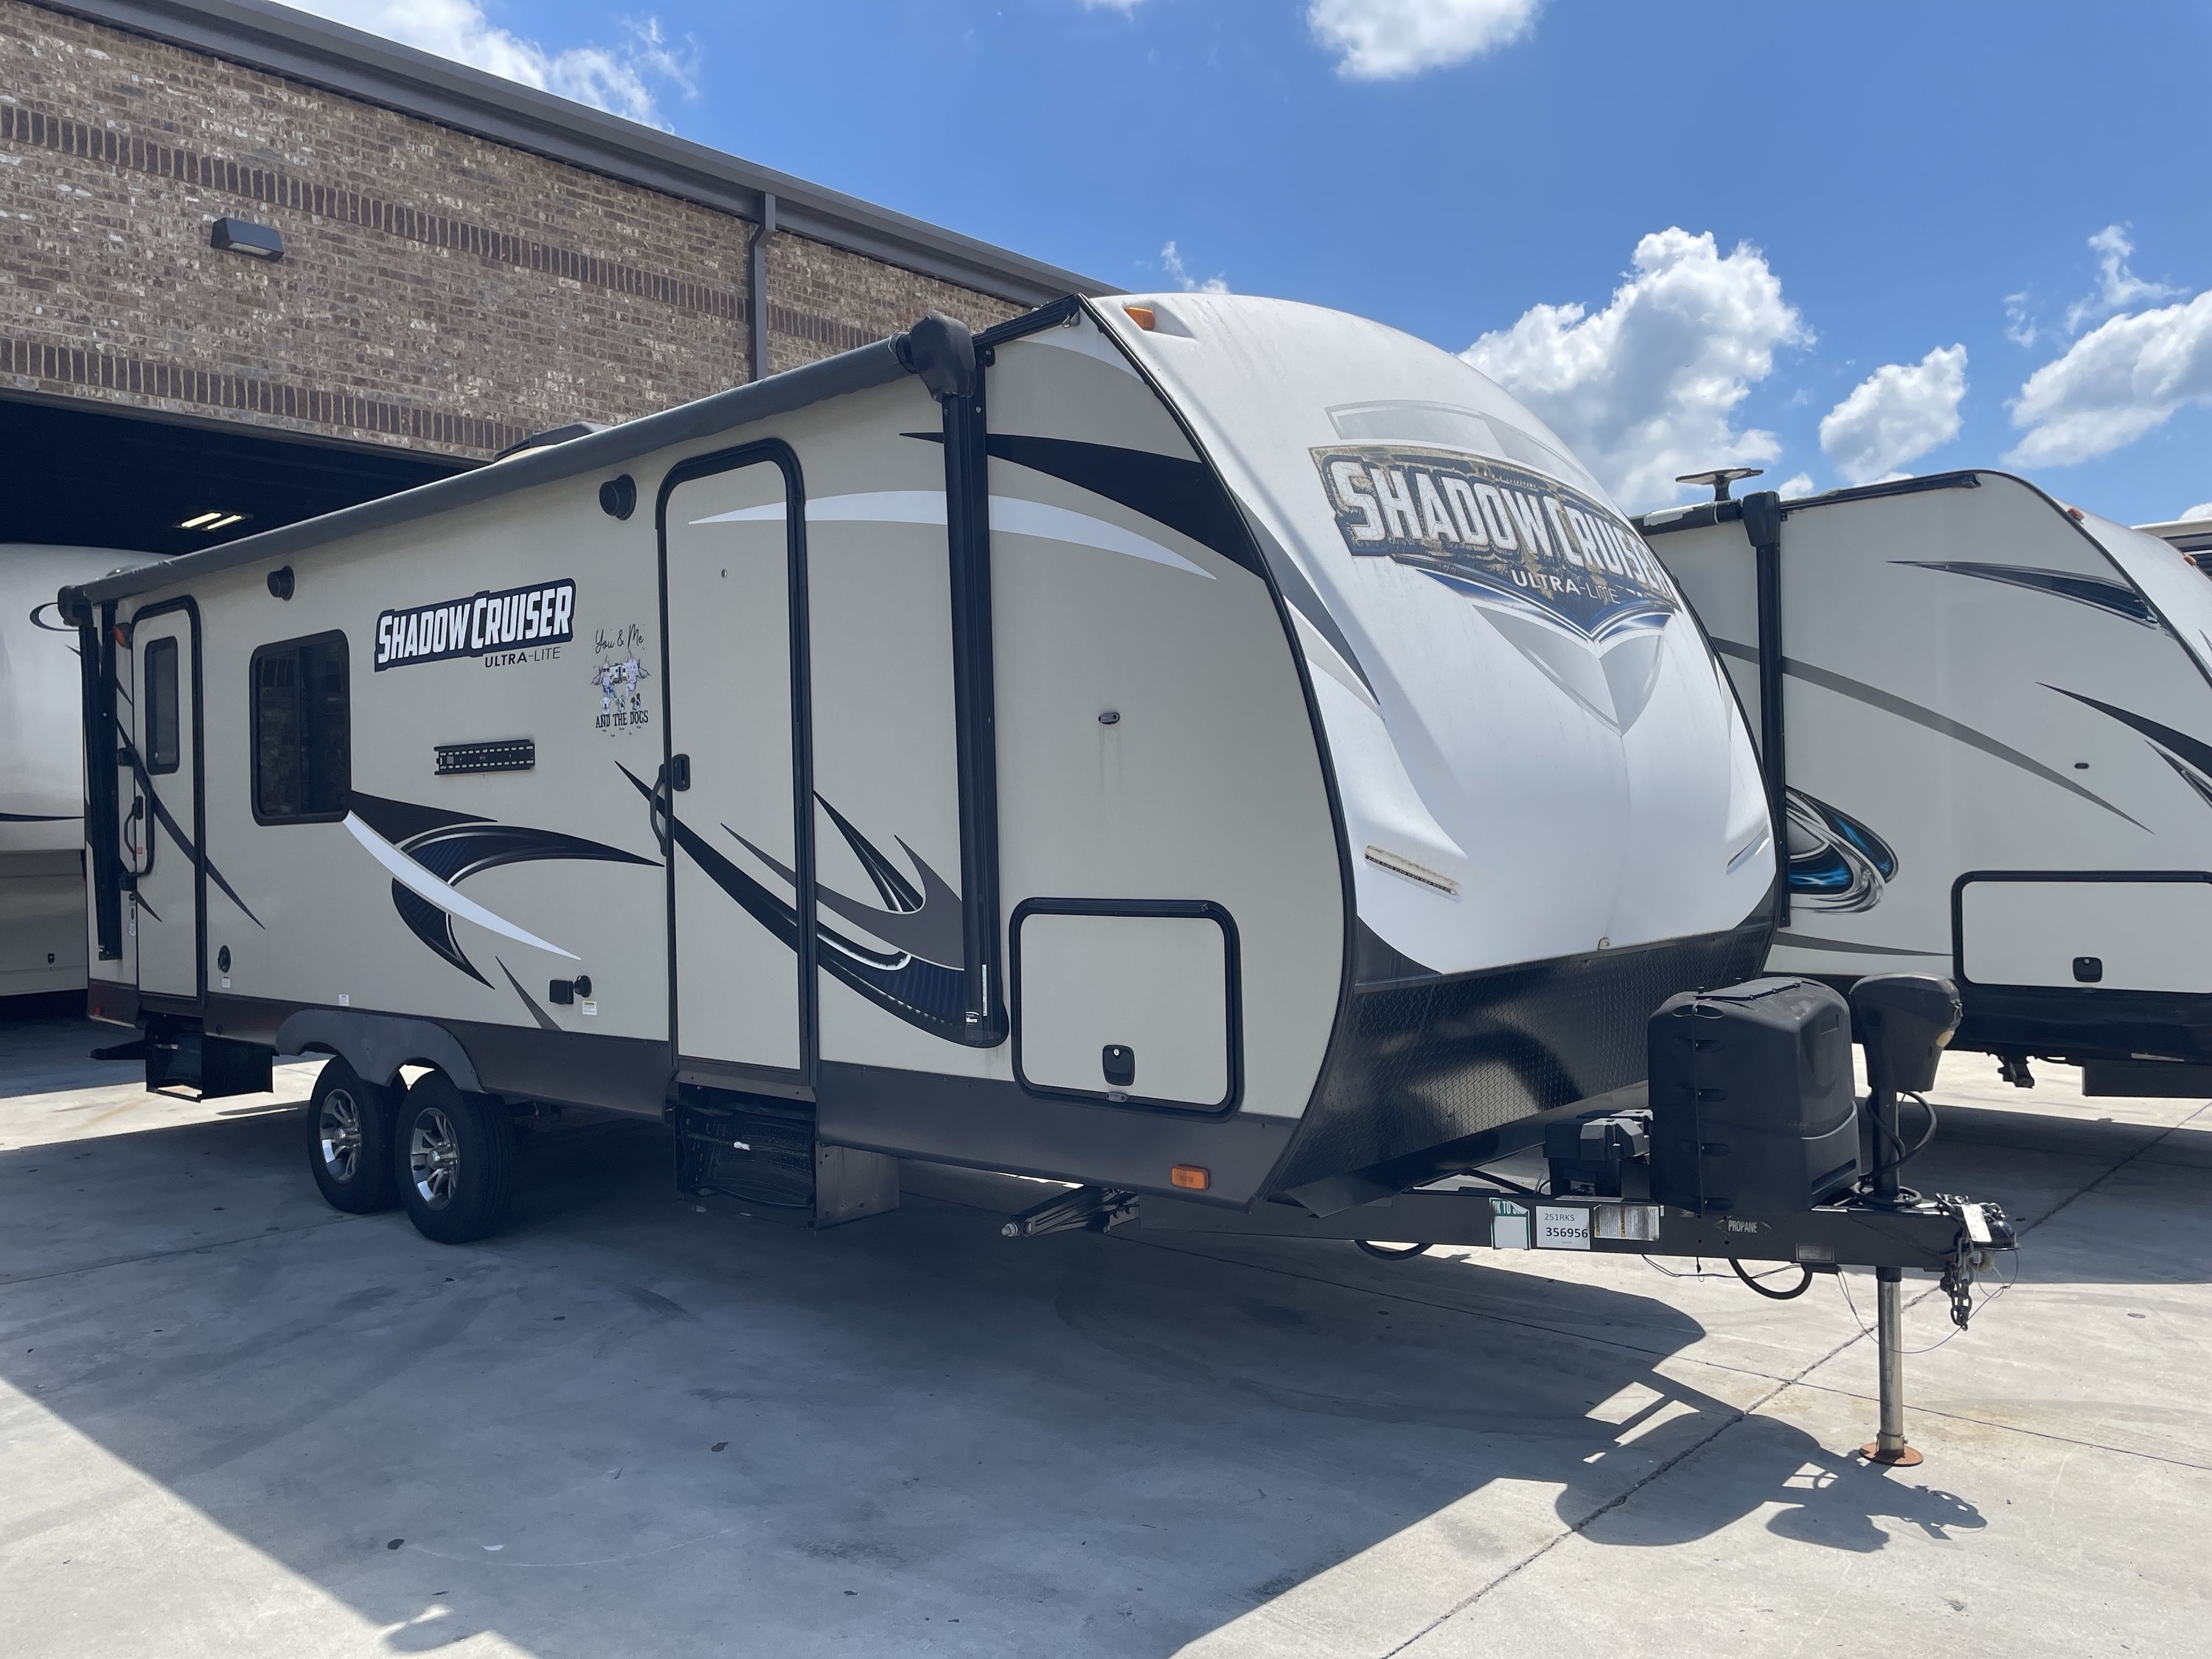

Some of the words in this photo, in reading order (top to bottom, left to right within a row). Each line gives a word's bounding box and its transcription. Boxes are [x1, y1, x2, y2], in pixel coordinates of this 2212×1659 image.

[1512, 568, 1621, 605] ULTRA-LITE
[378, 585, 573, 664] SHADOWCRUISER
[595, 629, 615, 654] You
[617, 629, 625, 647] &
[627, 623, 644, 650] Me
[484, 646, 561, 668] ULTRA-LITE
[596, 714, 611, 728] AND
[613, 712, 627, 727] THE
[630, 710, 649, 725] DOGS
[1544, 1213, 1575, 1222] 251RKS
[1728, 1220, 1757, 1233] PROPANE
[1545, 1227, 1588, 1238] 356956
